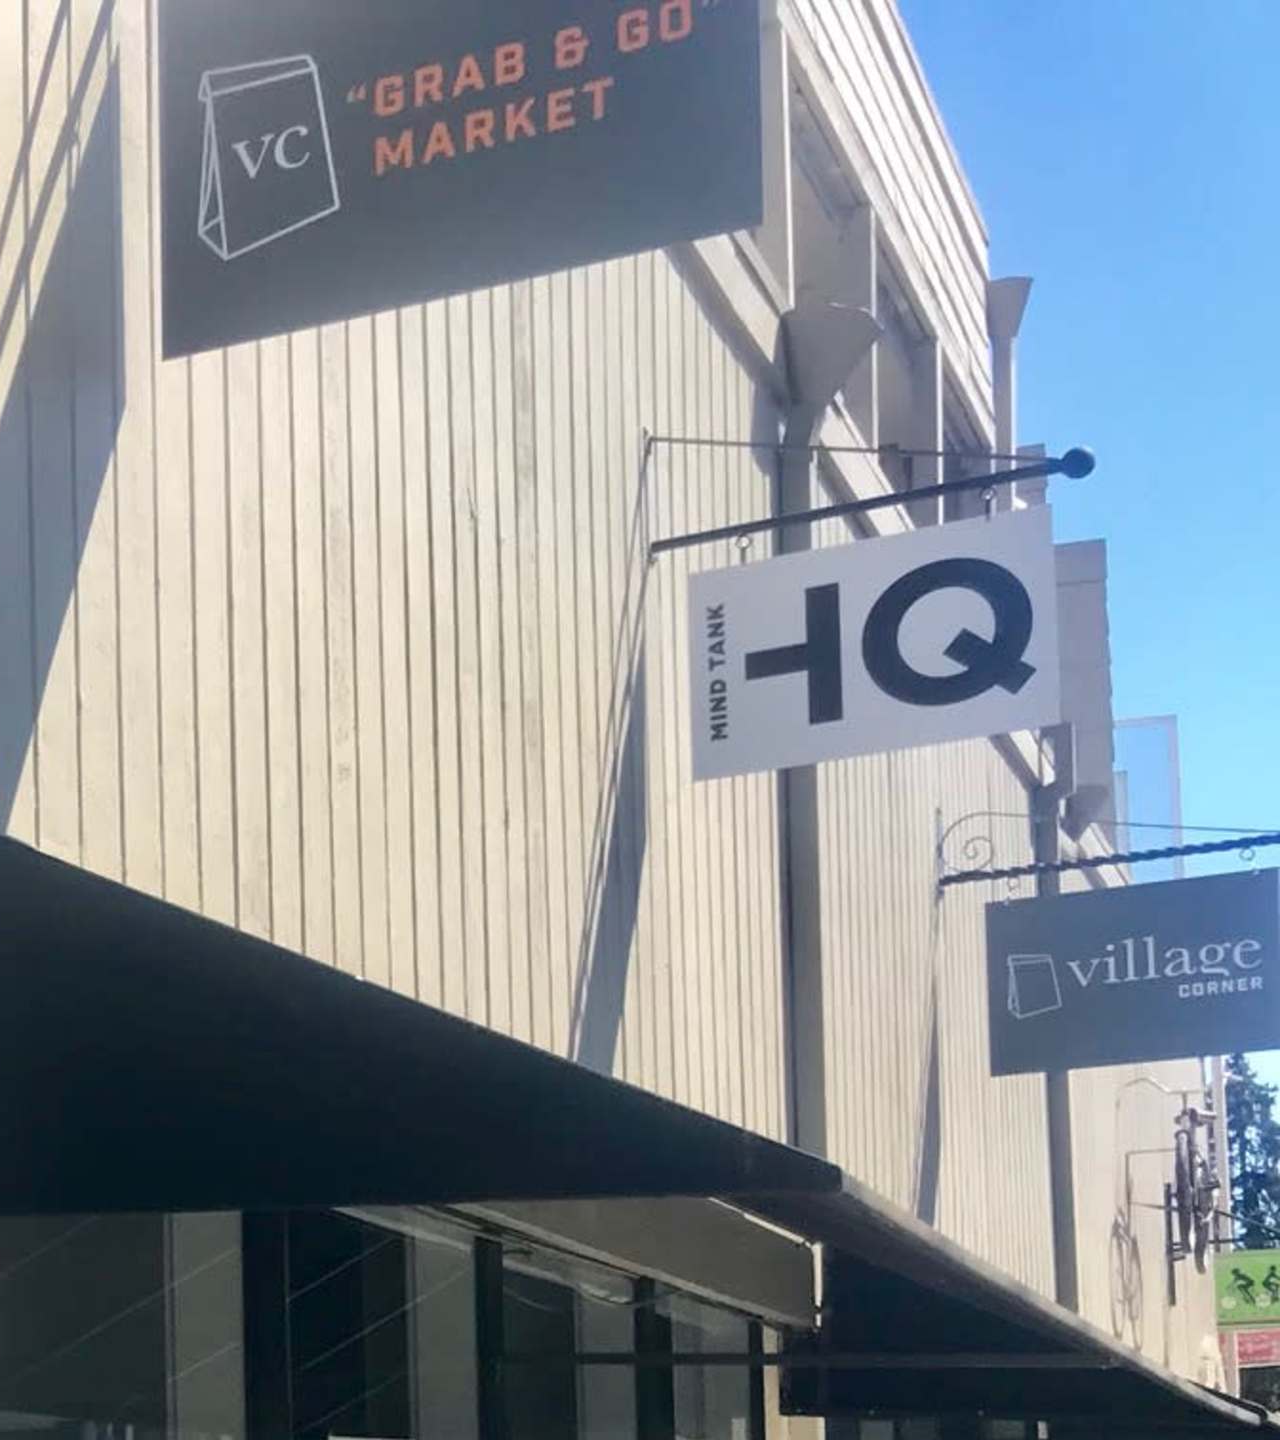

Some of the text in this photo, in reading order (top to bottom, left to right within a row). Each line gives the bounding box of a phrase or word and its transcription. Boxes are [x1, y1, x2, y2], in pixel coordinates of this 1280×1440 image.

[553, 26, 590, 70] &
[232, 123, 313, 181] VC
[373, 75, 615, 177] MARKET
[706, 603, 729, 742] MIND TANK
[1066, 933, 1264, 988] village
[1177, 975, 1264, 999] CORNER
